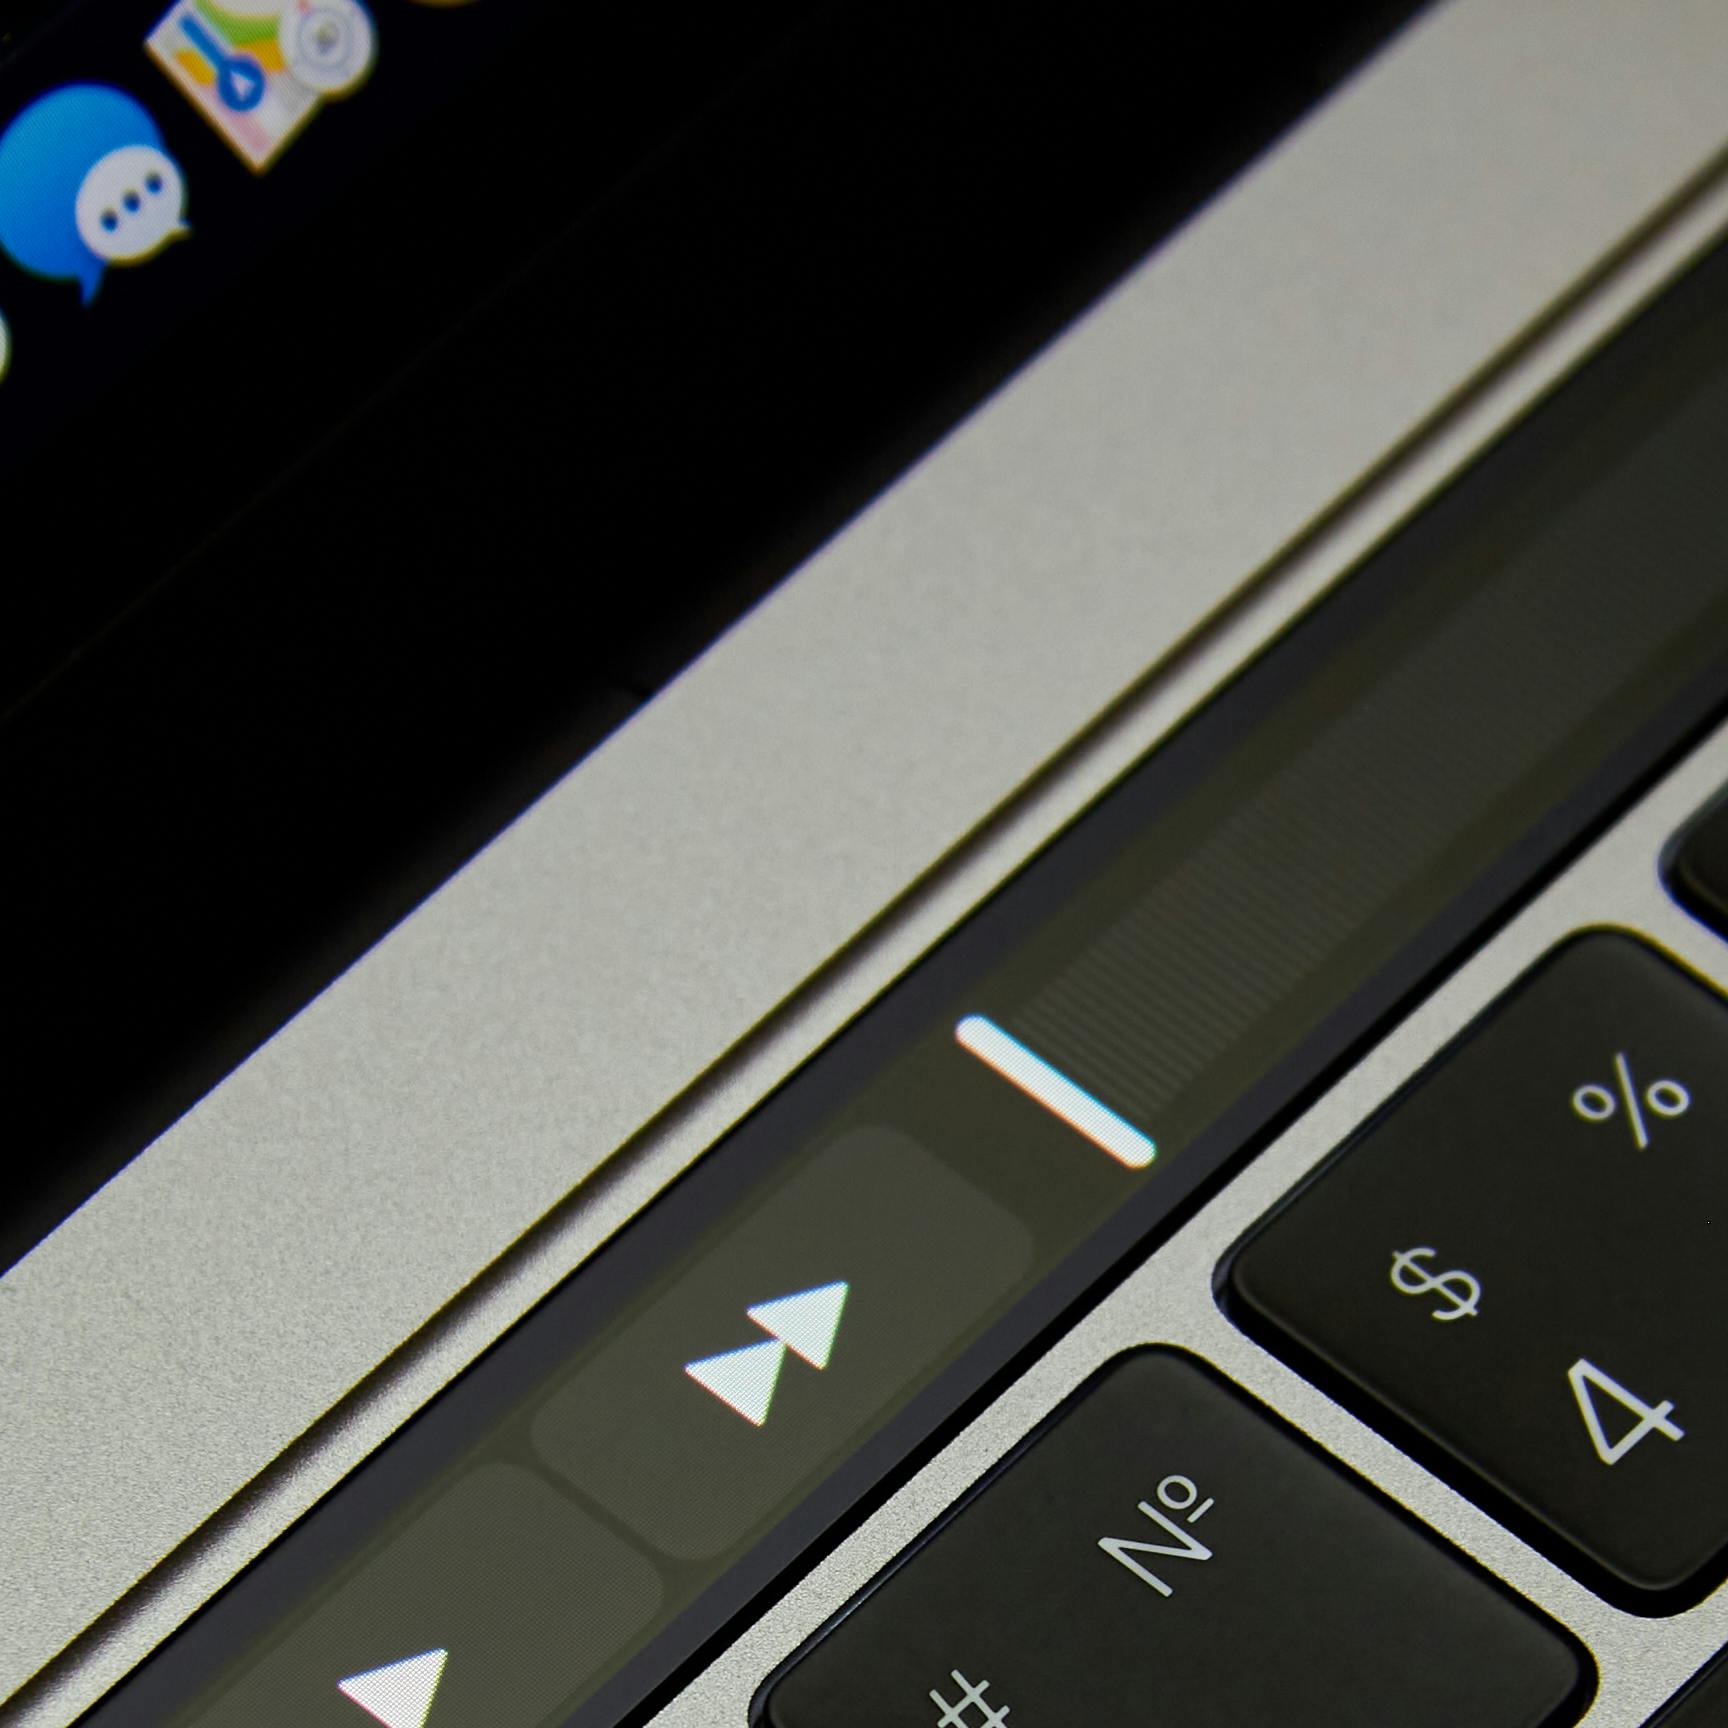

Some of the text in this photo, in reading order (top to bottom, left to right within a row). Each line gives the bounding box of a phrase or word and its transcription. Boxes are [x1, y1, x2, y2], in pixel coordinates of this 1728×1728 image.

[1571, 1053, 1692, 1149] %
[1390, 1246, 1483, 1322] $
[1567, 1358, 1686, 1466] 4
